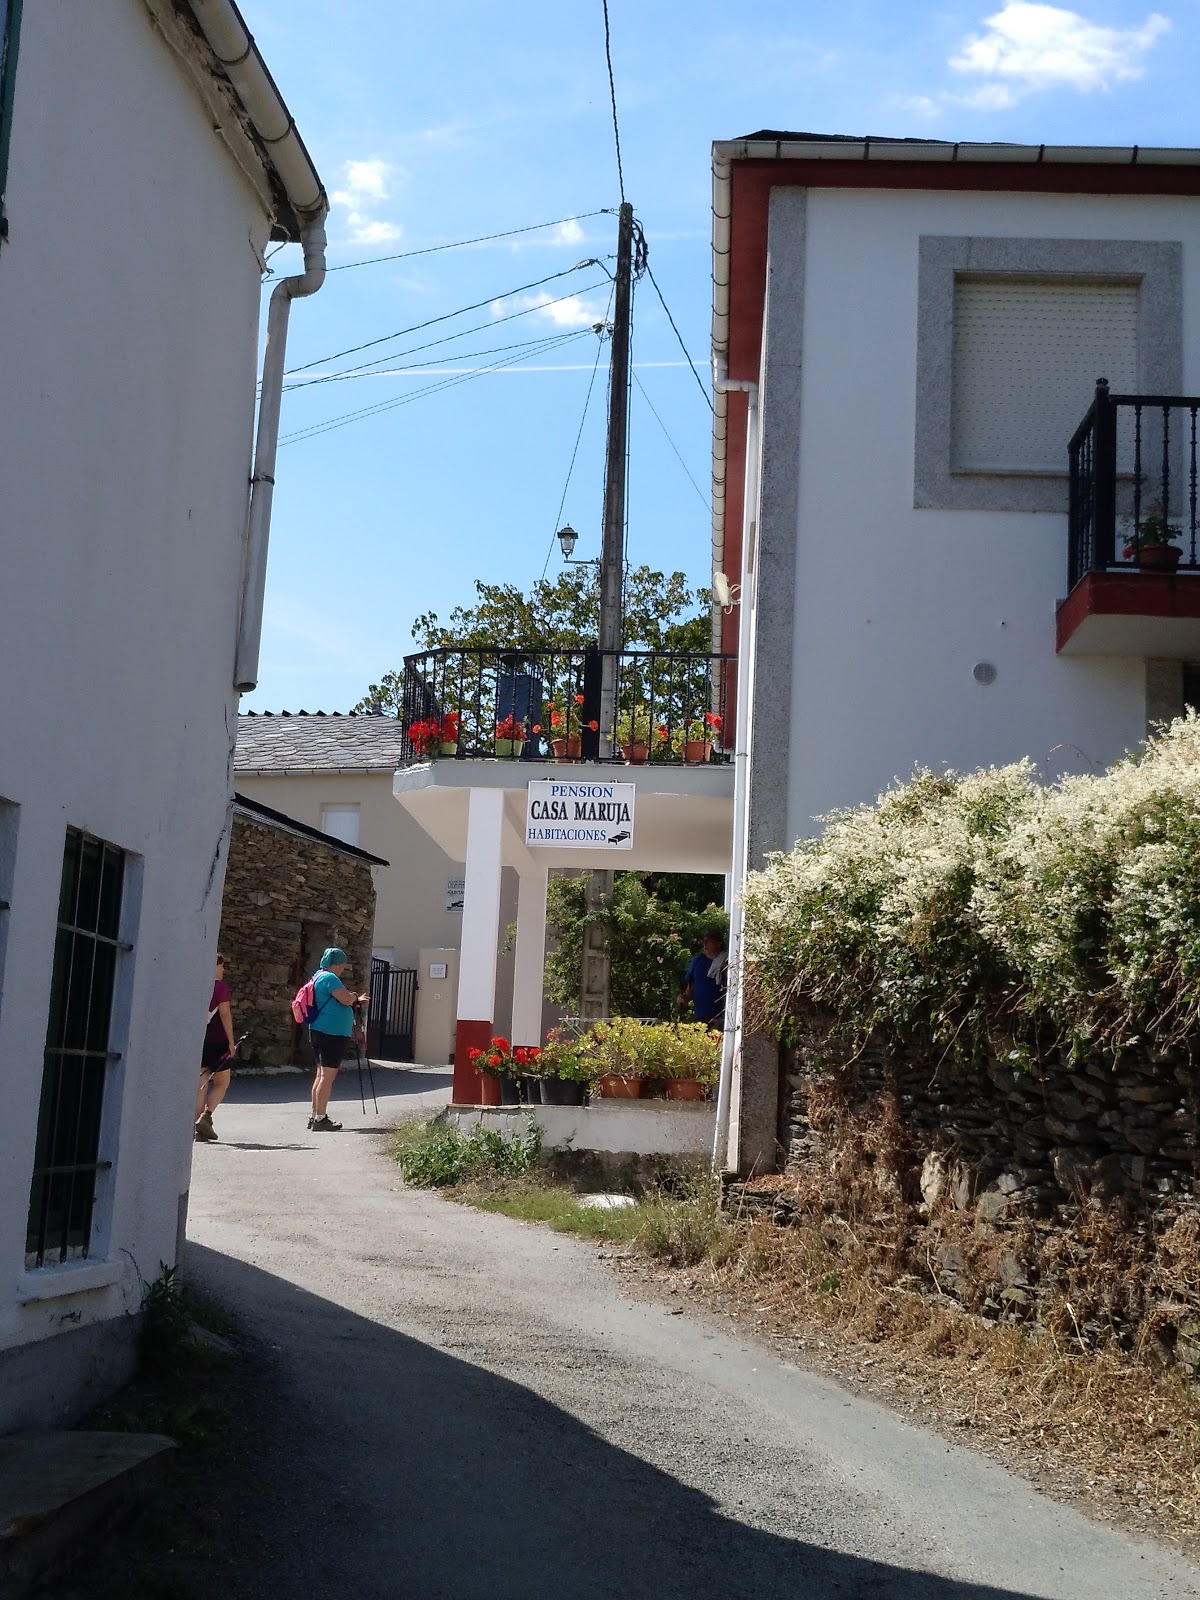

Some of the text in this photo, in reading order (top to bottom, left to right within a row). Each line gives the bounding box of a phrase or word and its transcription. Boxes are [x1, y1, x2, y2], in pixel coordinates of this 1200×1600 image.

[551, 785, 613, 798] PENSION
[531, 800, 631, 825] CASA MARUJA
[528, 828, 606, 841] HABITACIONES
